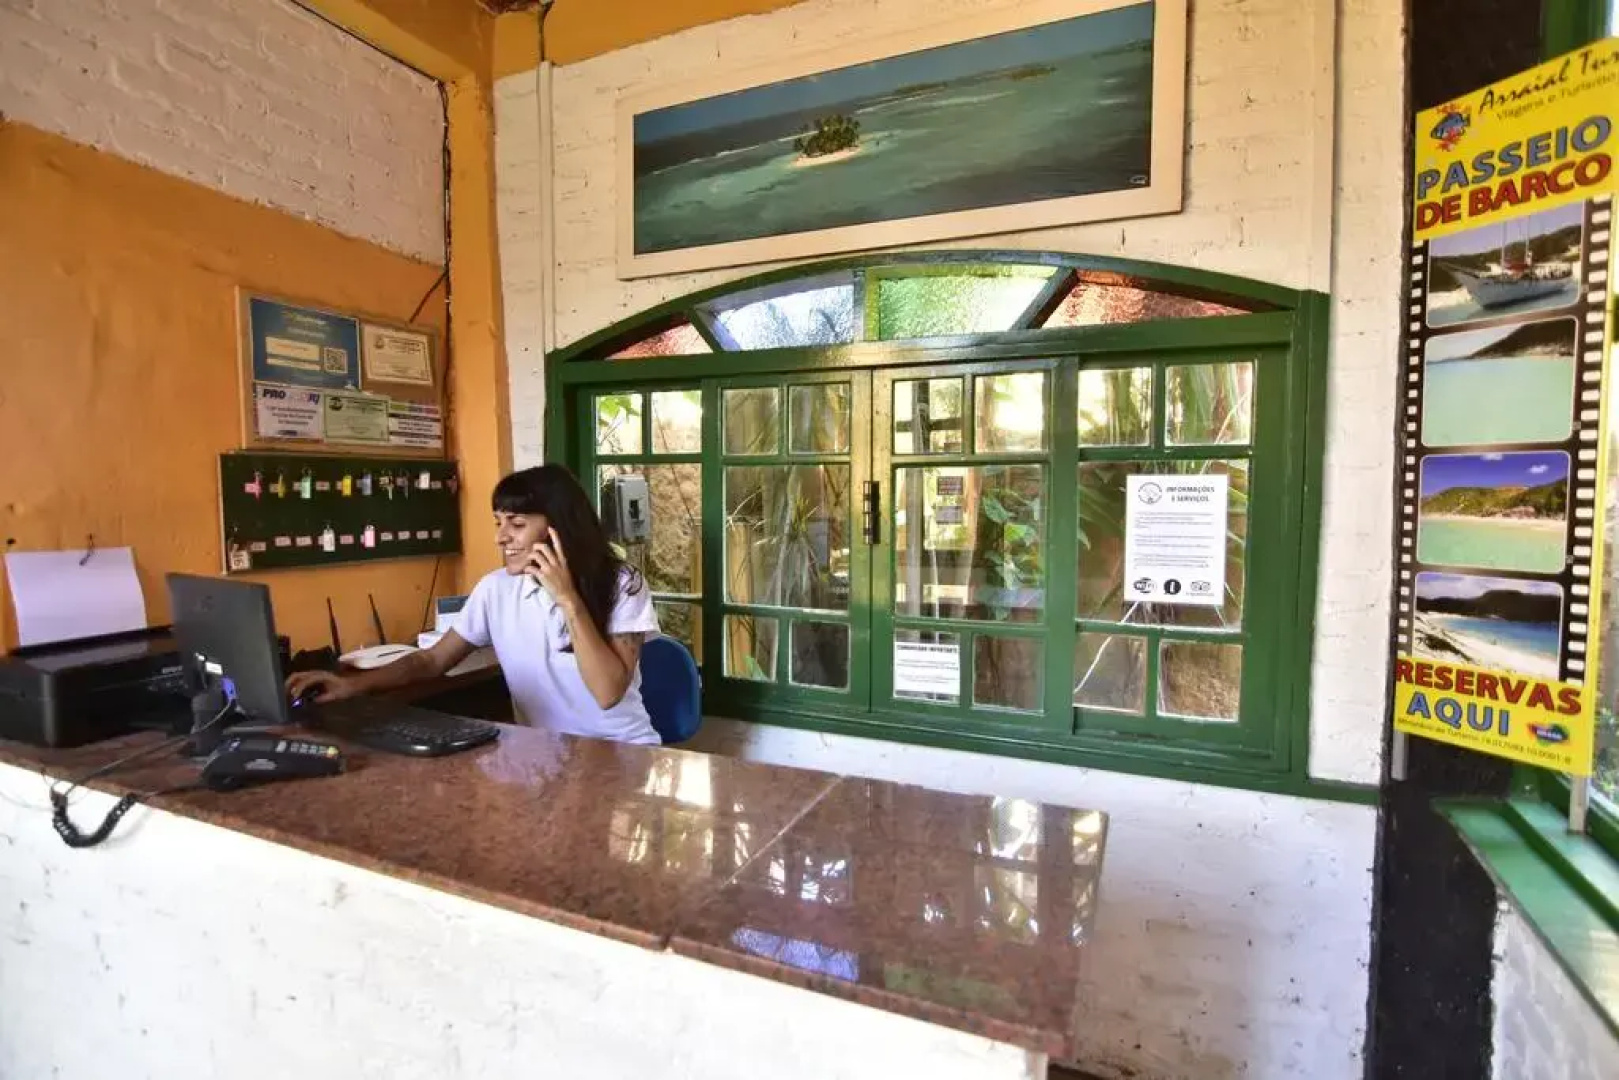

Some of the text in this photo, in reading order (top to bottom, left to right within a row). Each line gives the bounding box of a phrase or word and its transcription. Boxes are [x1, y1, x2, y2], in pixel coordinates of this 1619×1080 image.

[1478, 57, 1571, 114] Arraial
[1417, 115, 1612, 200] PASSEIO
[1416, 152, 1612, 231] DE BARCO
[1396, 658, 1582, 715] RESERVAS
[1406, 691, 1510, 736] AQUI
